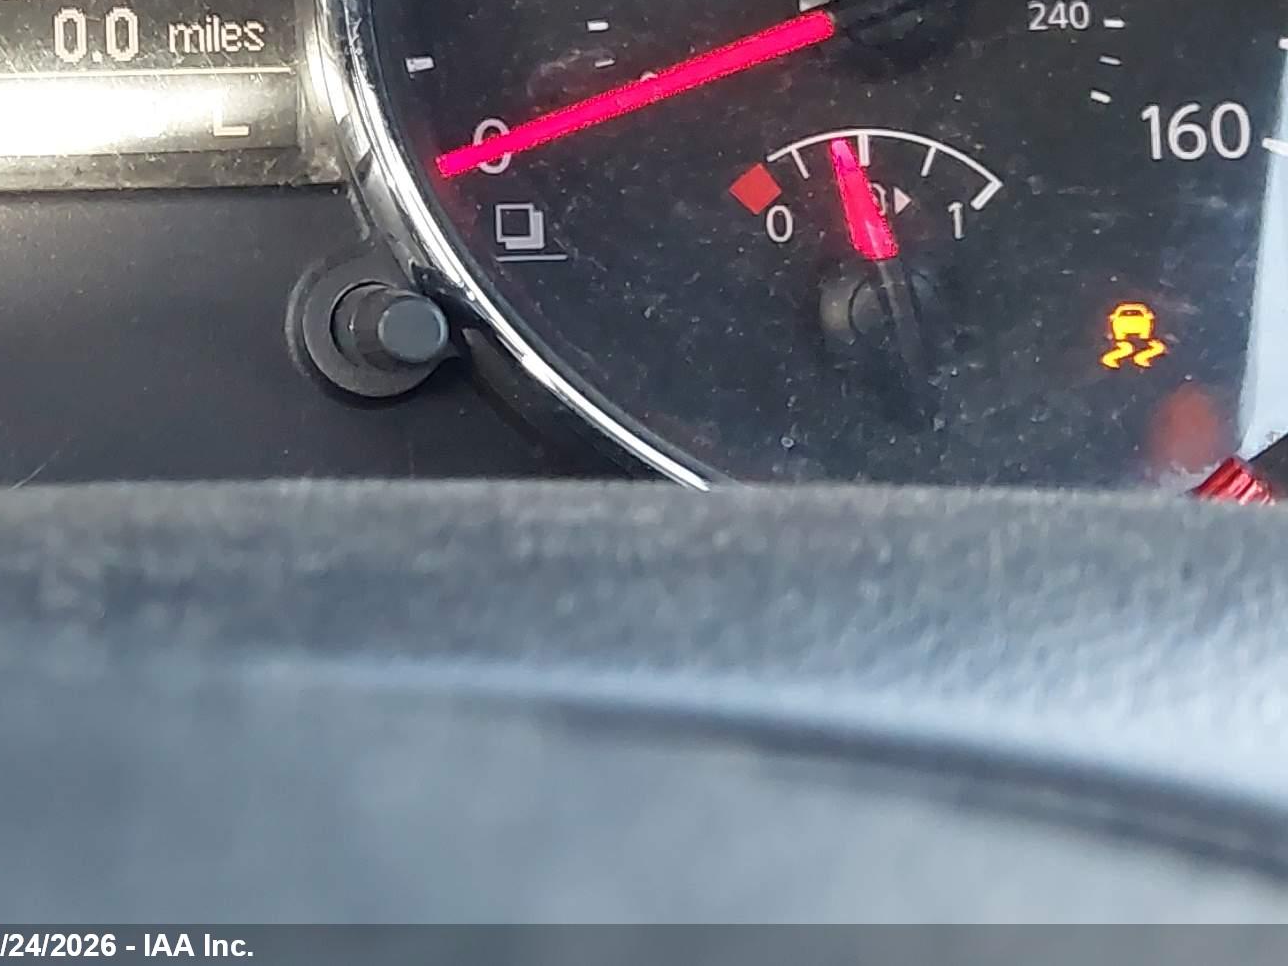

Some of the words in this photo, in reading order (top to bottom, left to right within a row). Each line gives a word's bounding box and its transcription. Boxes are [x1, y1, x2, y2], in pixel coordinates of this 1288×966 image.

[53, 6, 140, 64] 0.0
[168, 14, 265, 53] miles
[1028, 0, 1090, 31] 240
[473, 118, 512, 174] 0
[1141, 102, 1251, 160] 160
[765, 205, 794, 242] 0
[948, 203, 965, 239] 1
